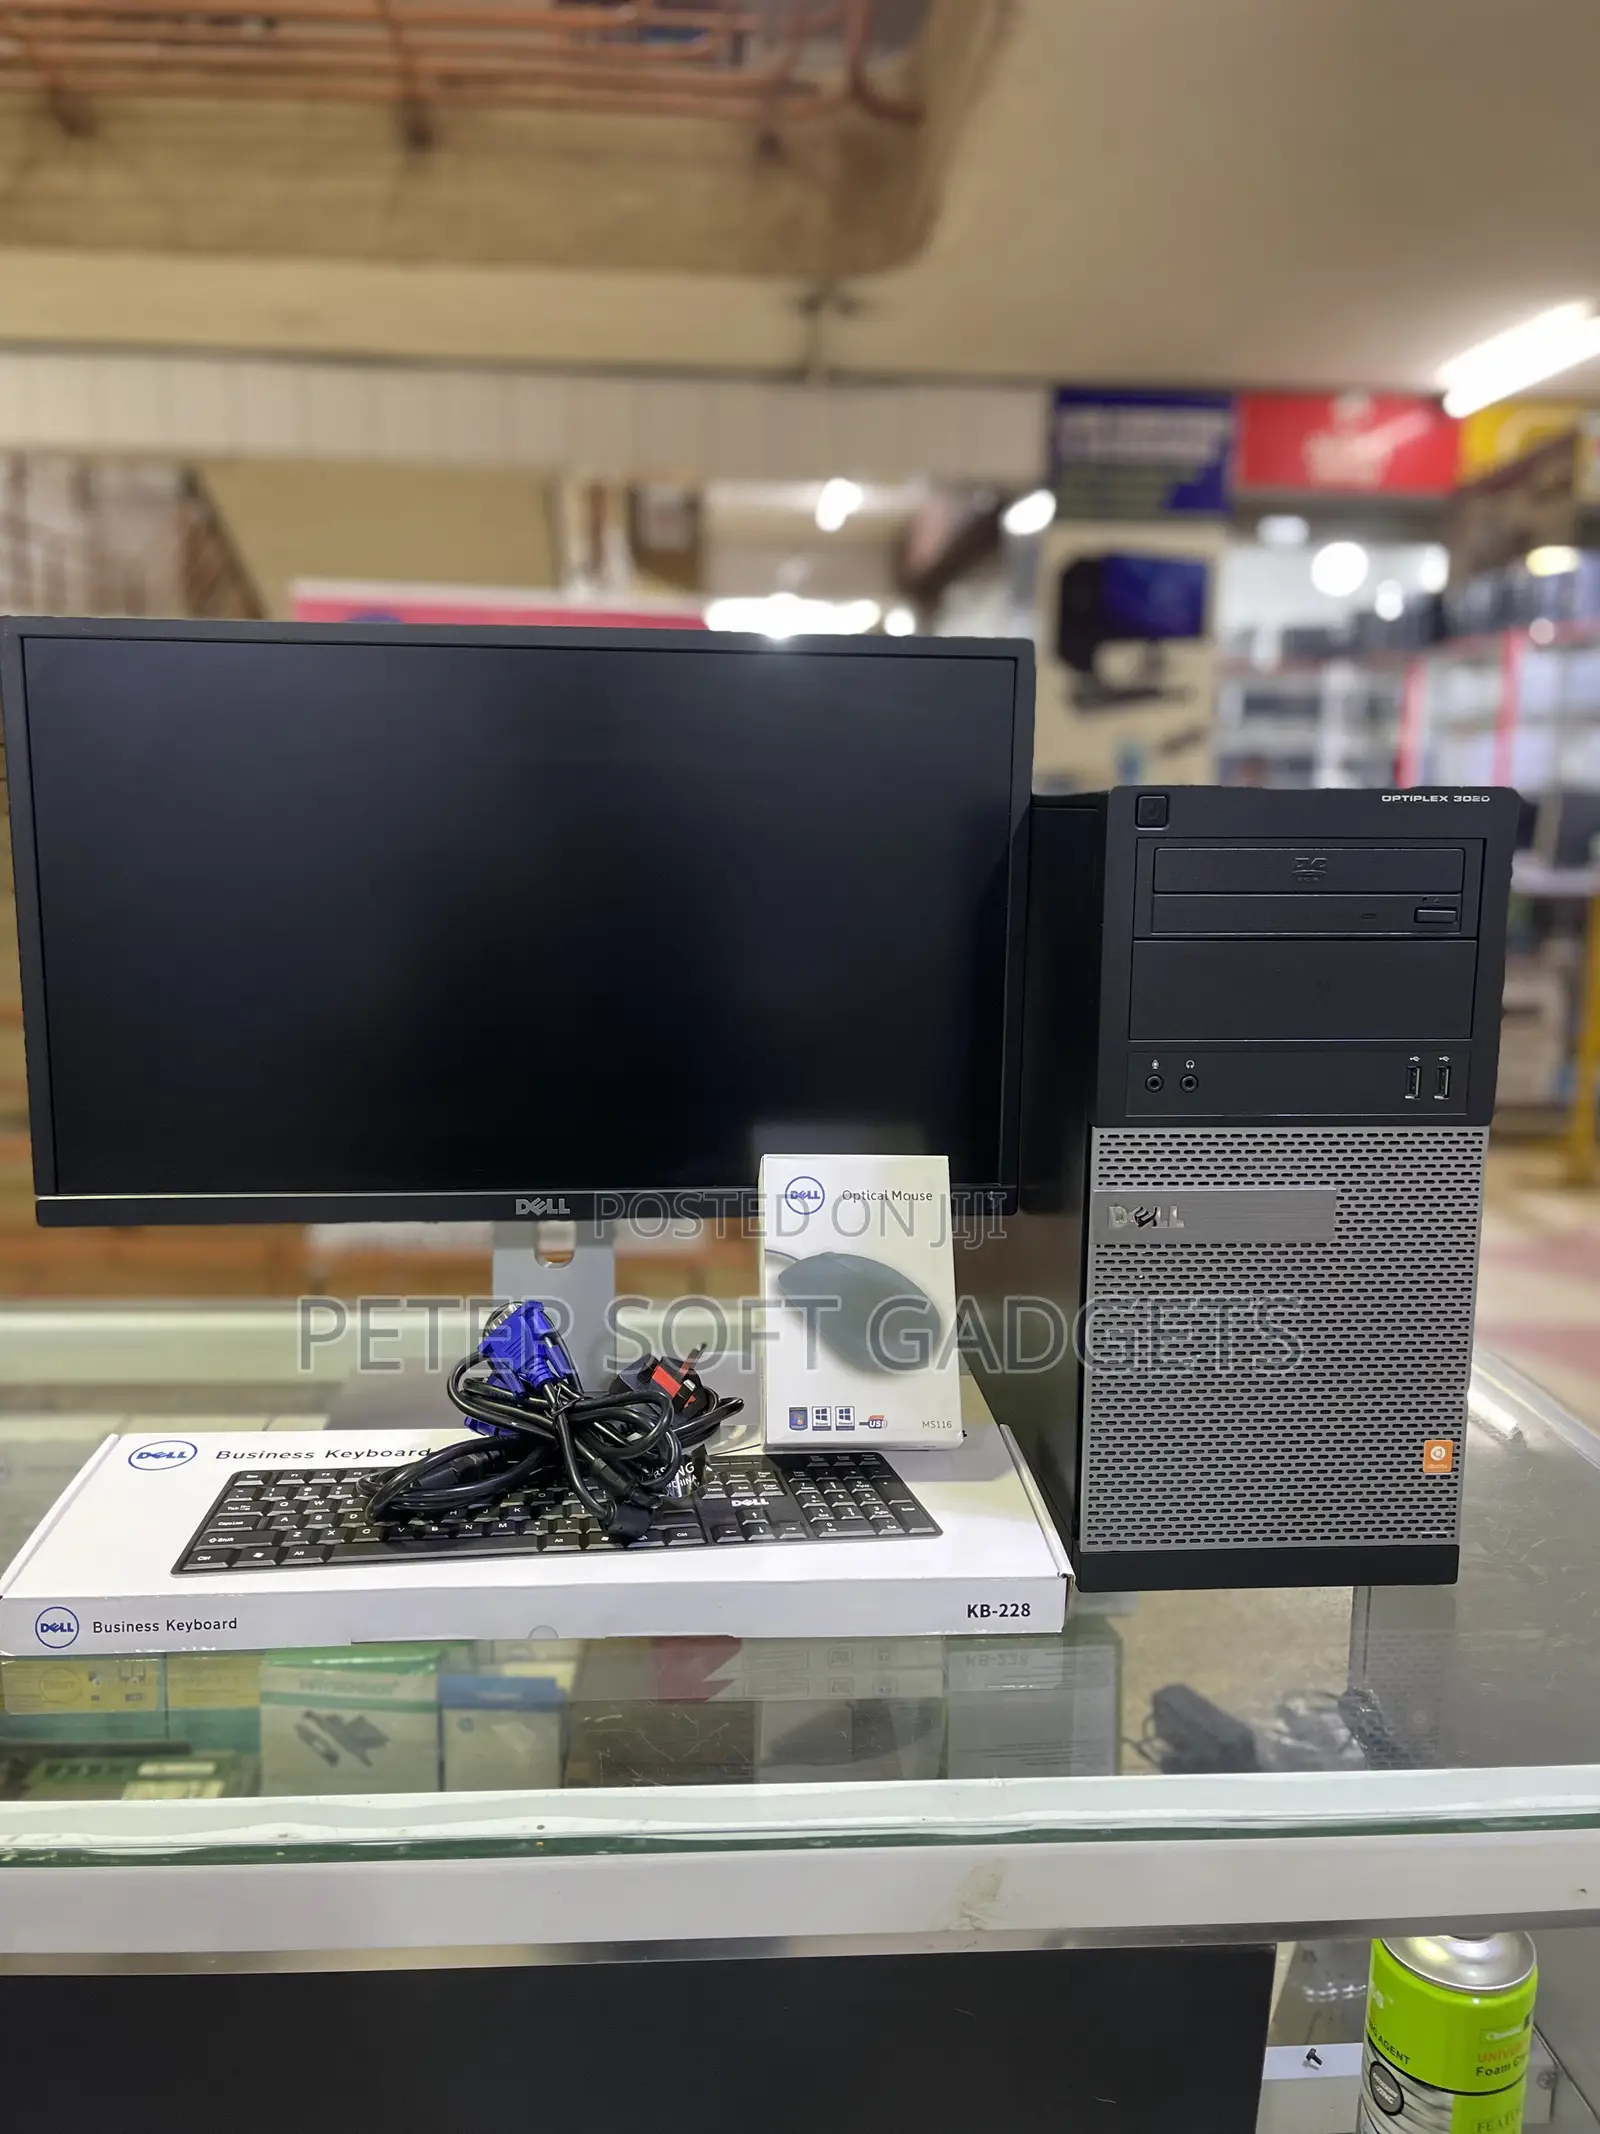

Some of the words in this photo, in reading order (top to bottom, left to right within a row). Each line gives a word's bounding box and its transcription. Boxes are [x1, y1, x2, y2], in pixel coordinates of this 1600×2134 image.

[789, 1190, 821, 1200] DELL
[842, 1190, 889, 1203] Optical
[891, 1190, 933, 1201] Mouse
[515, 1197, 571, 1216] DELL
[1108, 1205, 1185, 1228] DELL
[921, 1420, 953, 1429] MS116
[136, 1450, 187, 1459] DELL
[215, 1449, 315, 1460] Business
[325, 1447, 432, 1460] Keyboard
[731, 1498, 770, 1507] DELL
[967, 1602, 1031, 1619] KB-228
[40, 1622, 74, 1634] DELL
[92, 1620, 160, 1634] Business
[166, 1617, 238, 1634] Keyboard
[1378, 2034, 1411, 2065] AGENT
[1475, 2062, 1511, 2077] Foam
